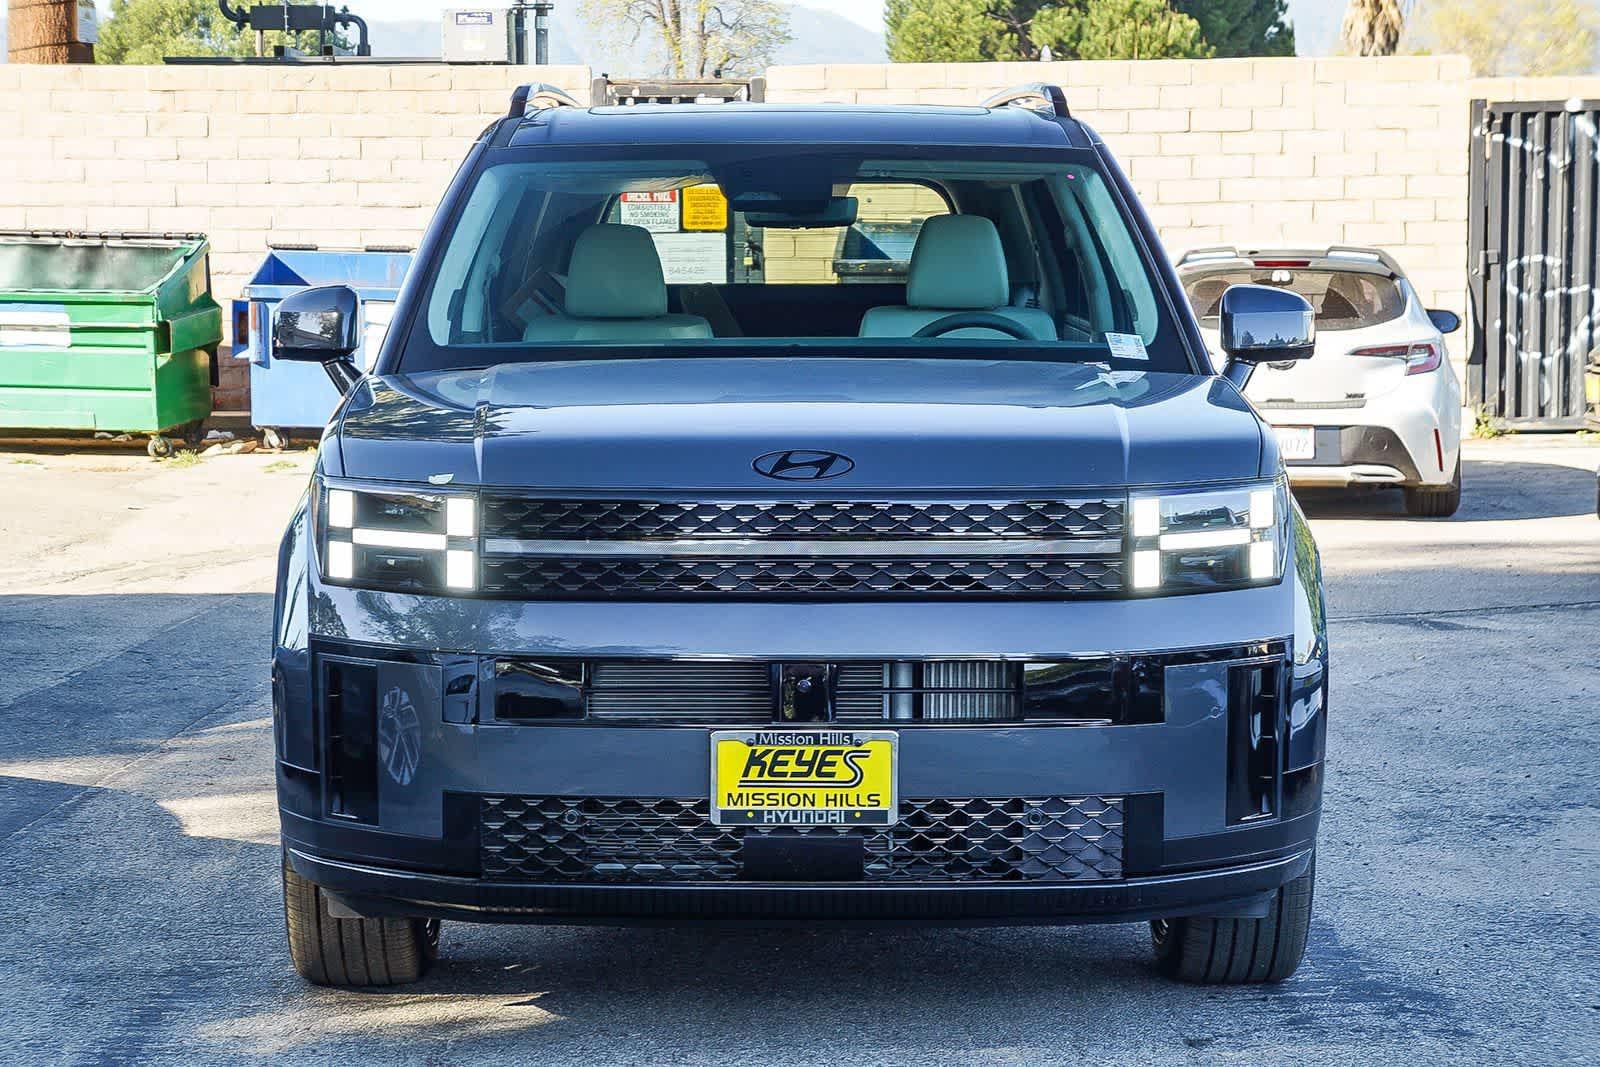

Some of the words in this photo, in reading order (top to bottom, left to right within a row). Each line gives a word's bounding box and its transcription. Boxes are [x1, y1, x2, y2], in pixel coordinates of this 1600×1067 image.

[759, 732, 814, 745] Mission
[819, 732, 851, 745] Hills
[738, 748, 872, 788] KEYES
[727, 793, 816, 807] MISSION
[825, 793, 881, 807] HILLS
[763, 811, 845, 824] HYUNDAI
